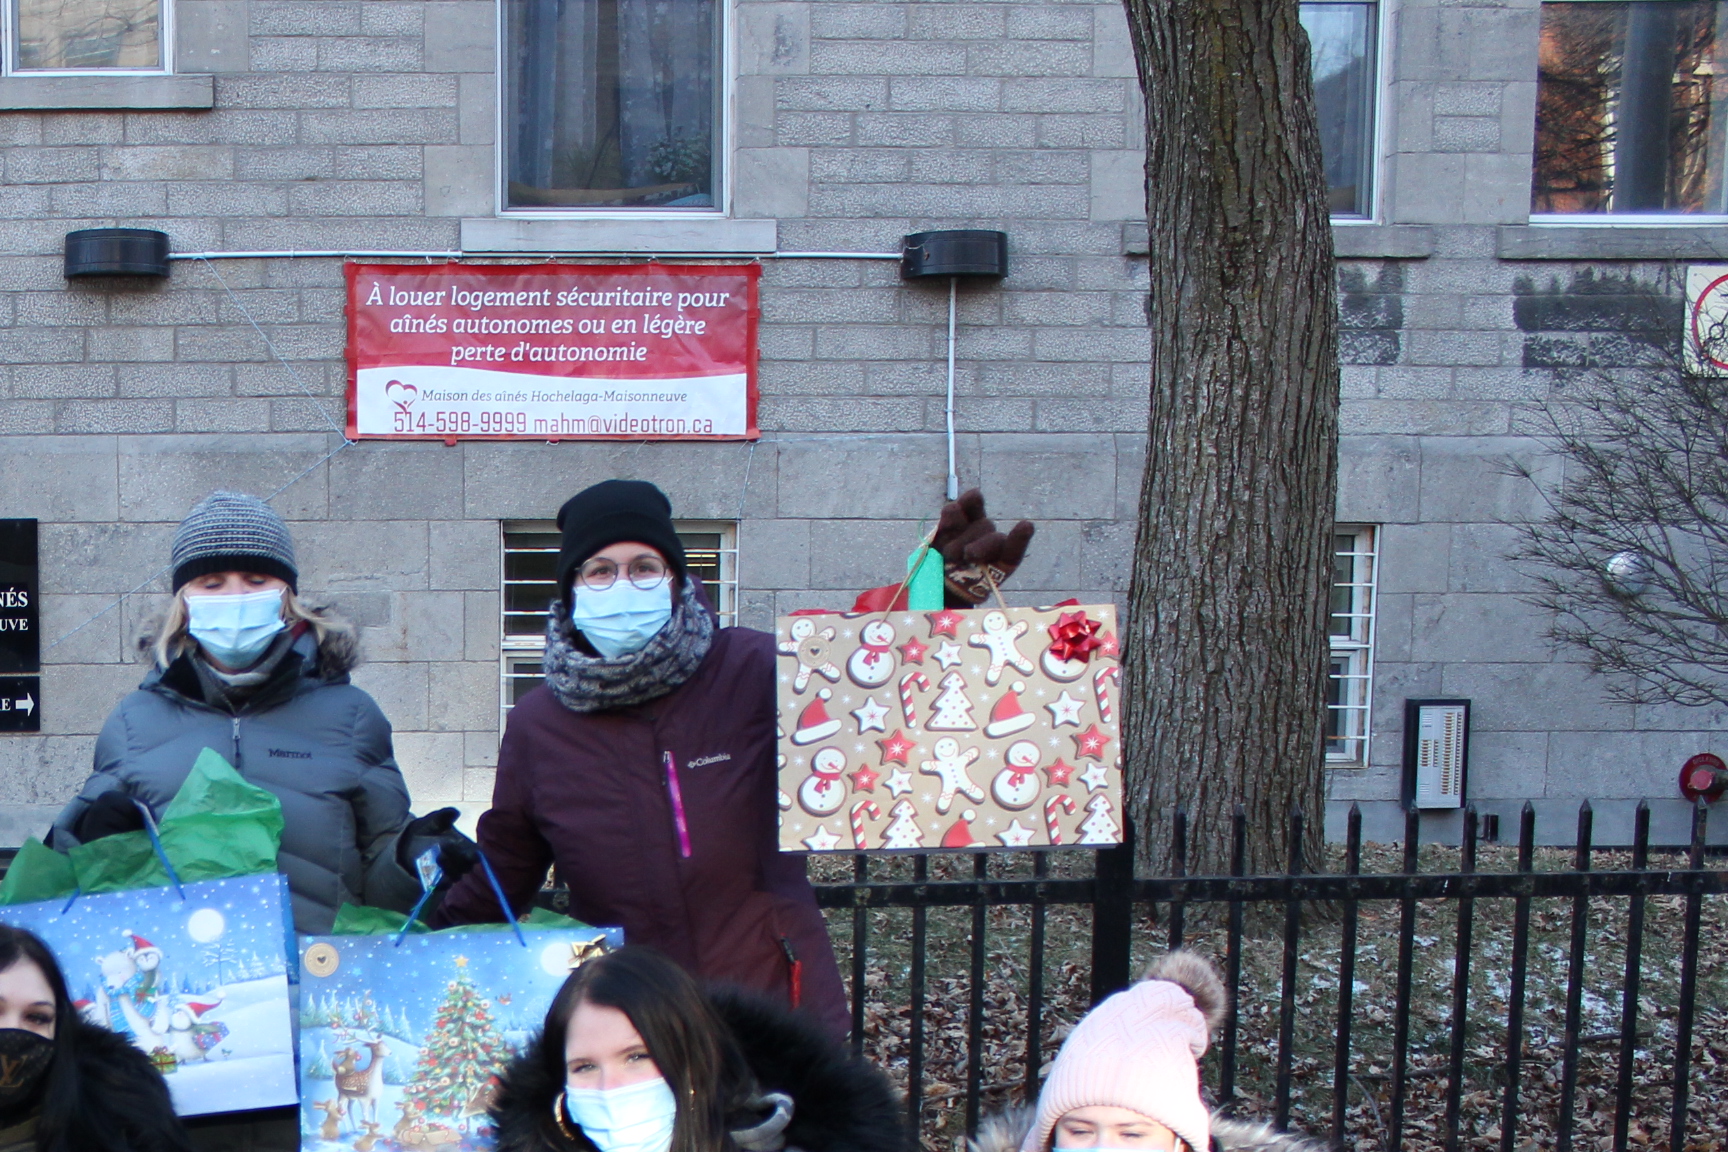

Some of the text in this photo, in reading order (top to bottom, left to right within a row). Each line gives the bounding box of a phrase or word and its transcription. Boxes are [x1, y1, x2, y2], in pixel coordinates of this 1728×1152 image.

[366, 281, 730, 312] À louer logement sécuritaire pour
[390, 313, 706, 339] aînés autonomes ou en légère
[451, 341, 647, 365] perte d'autonomie
[421, 389, 687, 404] Maison des aînés Hochelaga-Maisonneuve
[394, 411, 713, 434] 514-598-9999 mahm@videotron.ca
[268, 748, 313, 759] Marmot
[696, 753, 731, 766] Columbia
